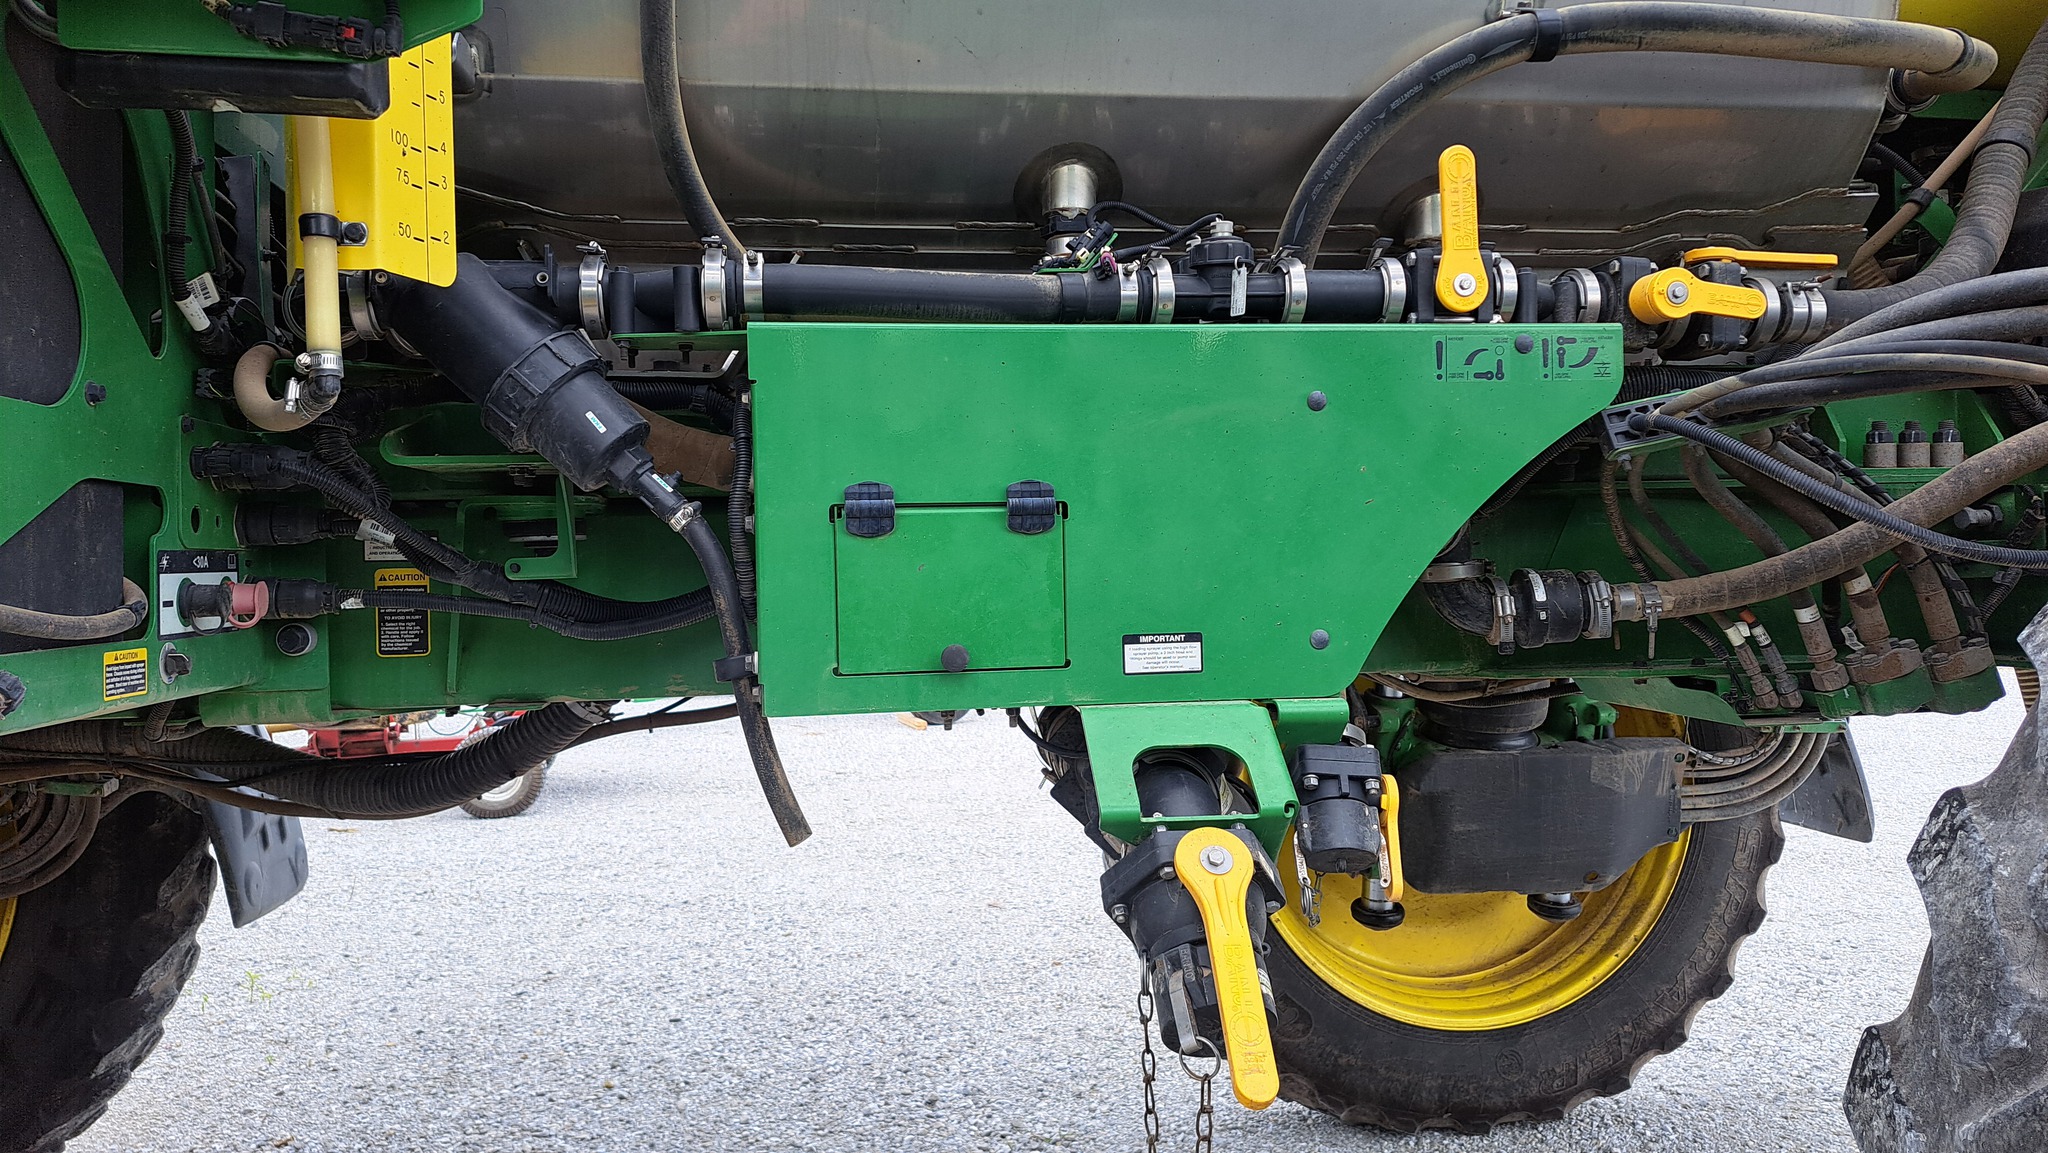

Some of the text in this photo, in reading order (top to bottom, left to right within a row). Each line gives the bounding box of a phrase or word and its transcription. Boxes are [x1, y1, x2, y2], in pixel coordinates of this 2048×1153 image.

[439, 91, 446, 104] 5
[390, 128, 409, 148] 100
[440, 141, 447, 155] 4
[396, 167, 410, 185] 75
[441, 175, 448, 190] 3
[398, 222, 412, 239] 50
[443, 230, 450, 245] 2
[1140, 634, 1186, 643] IMPORTANT
[119, 652, 139, 661] CAUTION
